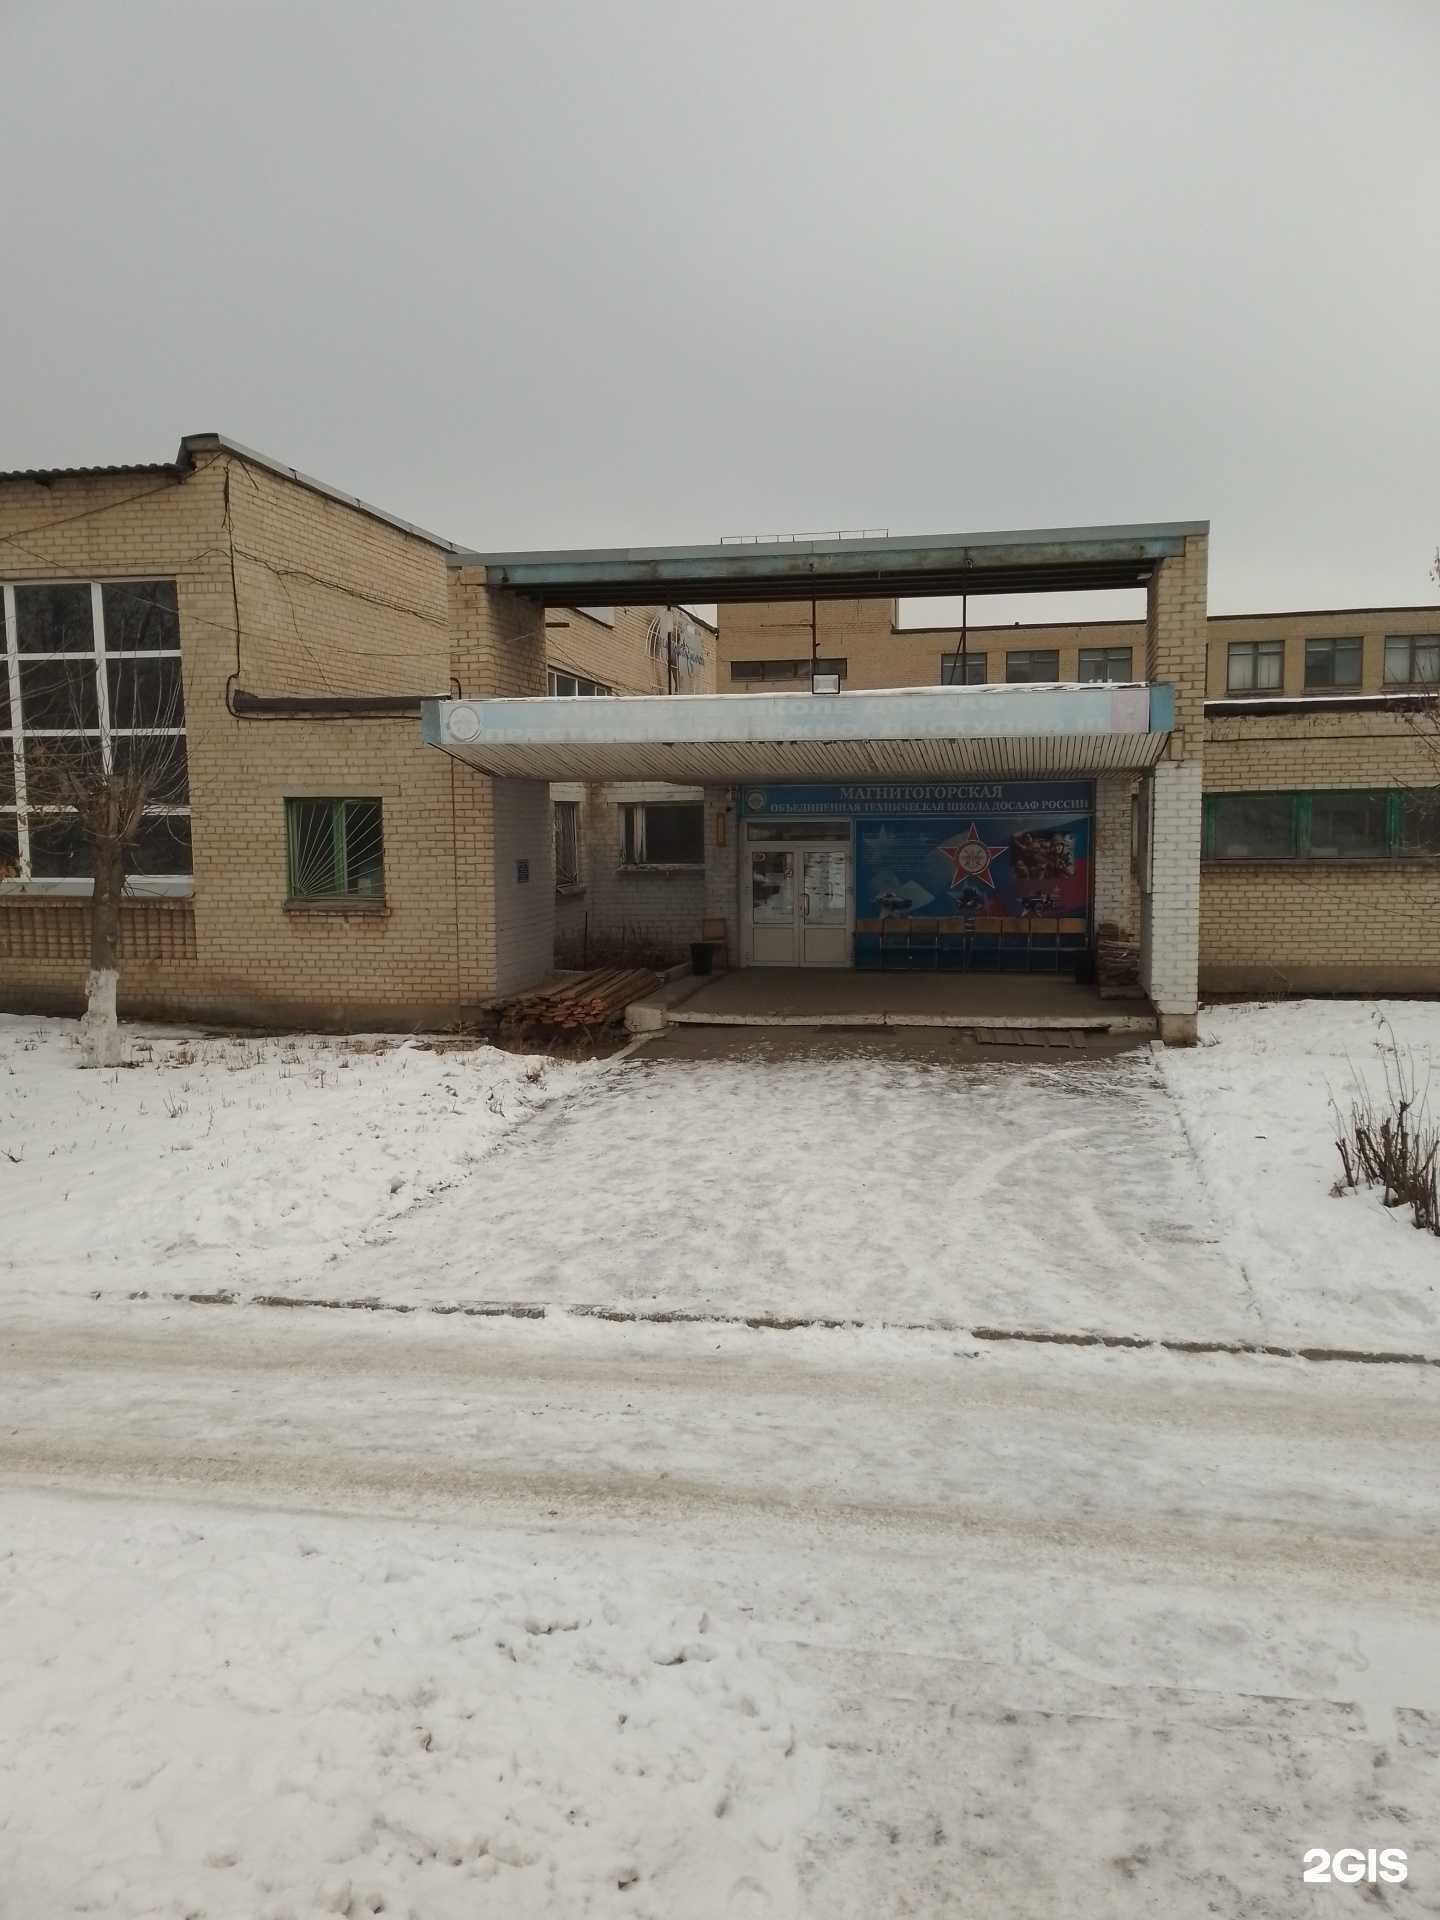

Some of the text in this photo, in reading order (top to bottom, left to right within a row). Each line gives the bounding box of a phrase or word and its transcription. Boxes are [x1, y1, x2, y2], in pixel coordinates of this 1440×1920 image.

[840, 785, 1004, 800] МАГНИТОГОРСКАЯ
[864, 800, 945, 812] ТЕХНИЧЕСКАЯ
[947, 800, 990, 811] ШКОЛА
[992, 800, 1039, 812] ДОСААФ
[1041, 798, 1088, 810] РОССИИ
